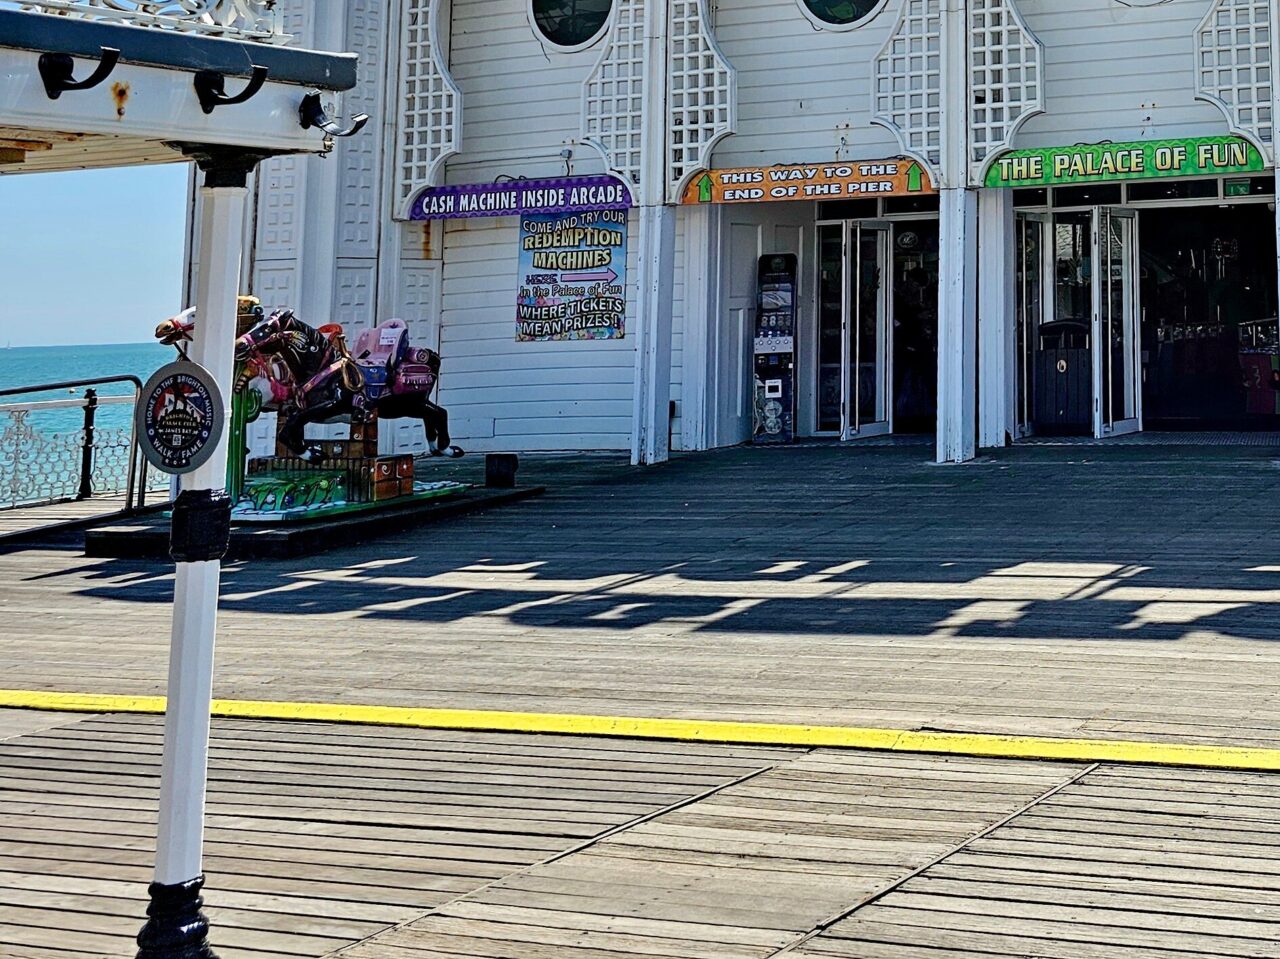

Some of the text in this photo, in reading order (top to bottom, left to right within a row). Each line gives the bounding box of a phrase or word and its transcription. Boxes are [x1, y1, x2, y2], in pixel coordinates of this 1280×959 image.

[999, 142, 1248, 180] THE PALACE OF FUN
[720, 164, 898, 184] THIS WAY TO THE
[422, 185, 623, 214] CASH MACHINE INSIDE ARCADE
[724, 181, 893, 201] END OF THE PIER
[523, 210, 625, 233] COME AND TRY OUR
[523, 228, 622, 250] REDEMPTION
[533, 249, 611, 270] MACHINES
[520, 281, 622, 297] In the Palace of Fun
[526, 274, 558, 285] HERE
[520, 298, 623, 319] WHERE TICKETS
[522, 321, 561, 335] MEAN
[147, 399, 156, 424] HOME
[153, 387, 162, 398] TO
[177, 375, 208, 399] BRIGHTON
[204, 399, 212, 425] MUSIC
[153, 438, 173, 458] WALK
[182, 439, 203, 458] FAME
